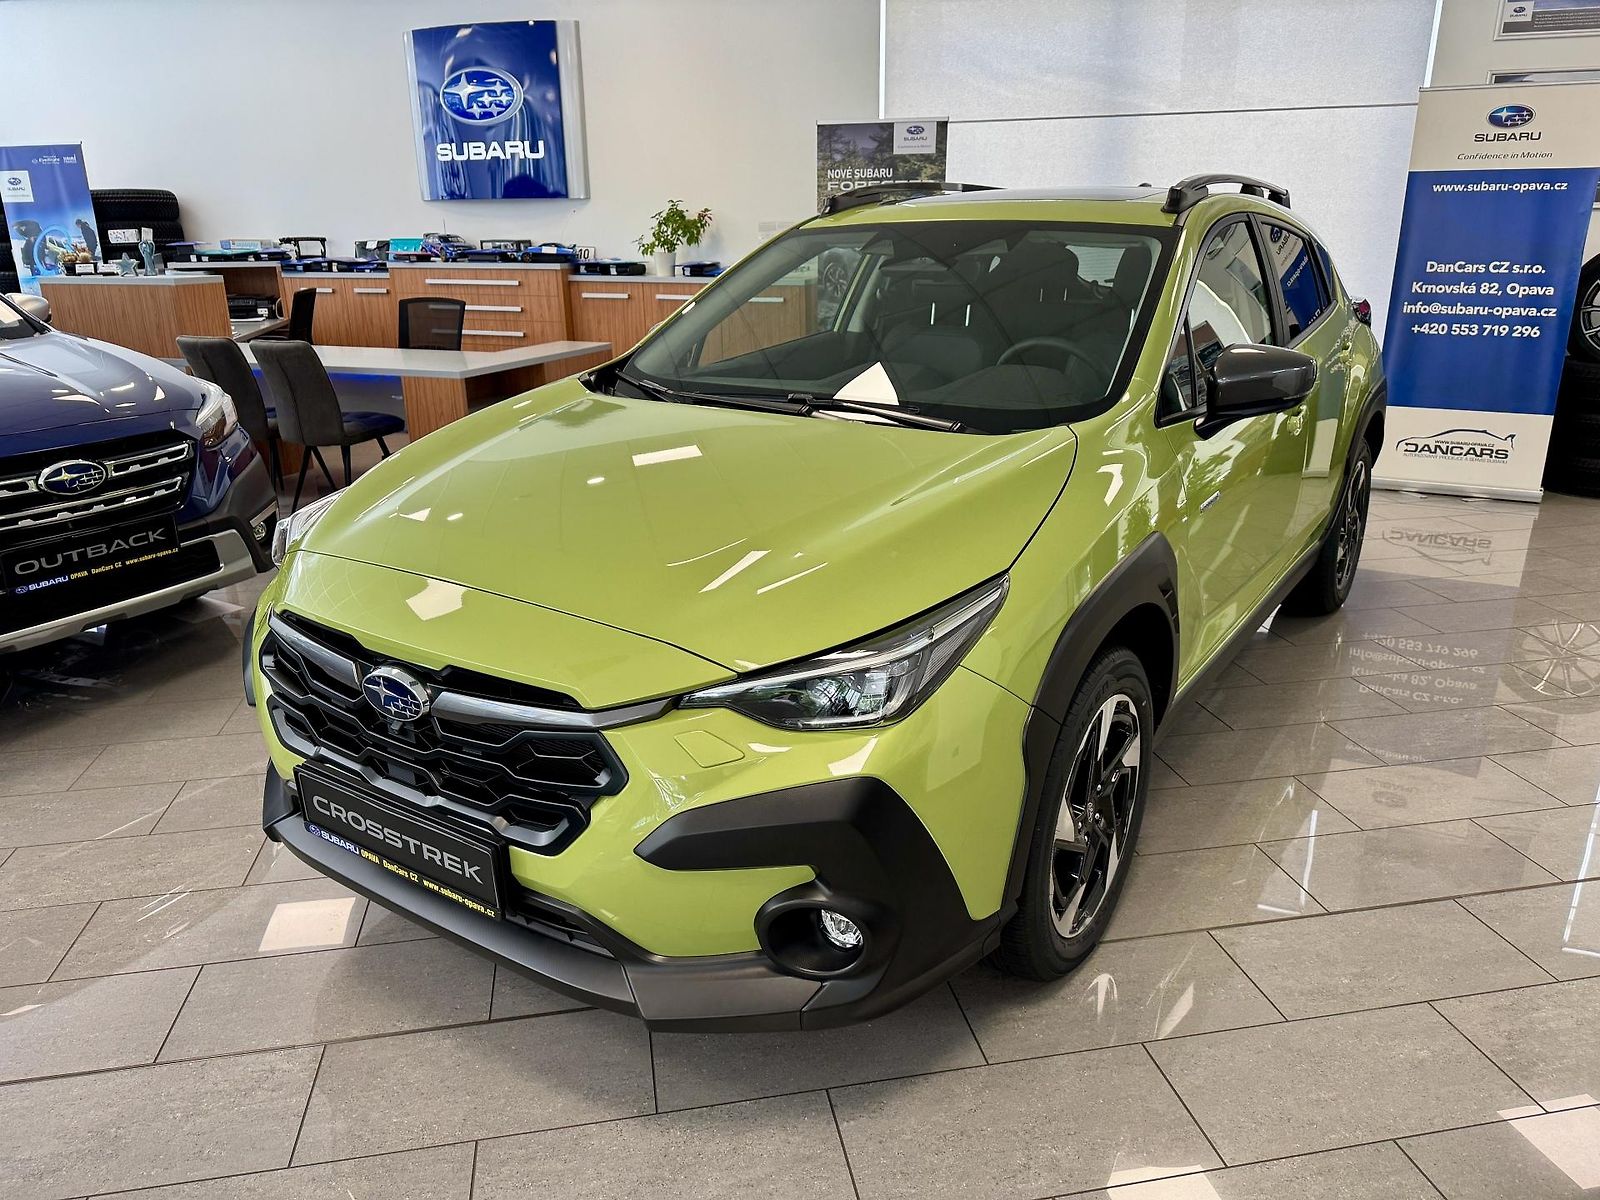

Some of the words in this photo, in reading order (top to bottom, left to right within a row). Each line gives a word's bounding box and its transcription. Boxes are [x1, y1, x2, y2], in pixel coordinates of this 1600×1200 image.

[1474, 131, 1542, 142] SUBARU
[436, 140, 545, 162] SUBARU
[1520, 151, 1553, 159] Motion
[827, 166, 853, 179] NOVÉ
[854, 168, 893, 178] SUBARU
[1433, 181, 1568, 193] www.subaru-opava.cz
[1426, 261, 1486, 273] DanCars
[1488, 262, 1509, 273] CZ
[1512, 263, 1546, 274] s.r.o.
[1411, 281, 1476, 294] Krnovská
[1480, 282, 1502, 296] 82,
[1506, 283, 1555, 298] Opava
[1402, 301, 1558, 318] info@subaru-opava.cz
[1411, 323, 1448, 335] +420
[1451, 324, 1479, 336] 553
[1482, 324, 1509, 337] 719
[1512, 325, 1541, 338] 296
[1403, 442, 1509, 460] DANCARS
[14, 527, 166, 575] OUTBACK
[29, 575, 69, 591] SUBARU
[70, 570, 88, 580] OPAVA
[91, 564, 114, 575] DanCars
[114, 561, 123, 569] CZ
[125, 547, 179, 565] www.subaru-opava.cz
[312, 795, 484, 885] CROSSTREK
[321, 830, 360, 855] SUBARU
[361, 849, 380, 865] OPAVA
[383, 859, 409, 878] DanCars
[409, 871, 419, 882] CZ
[422, 879, 496, 918] www.subaru-opava.cz
